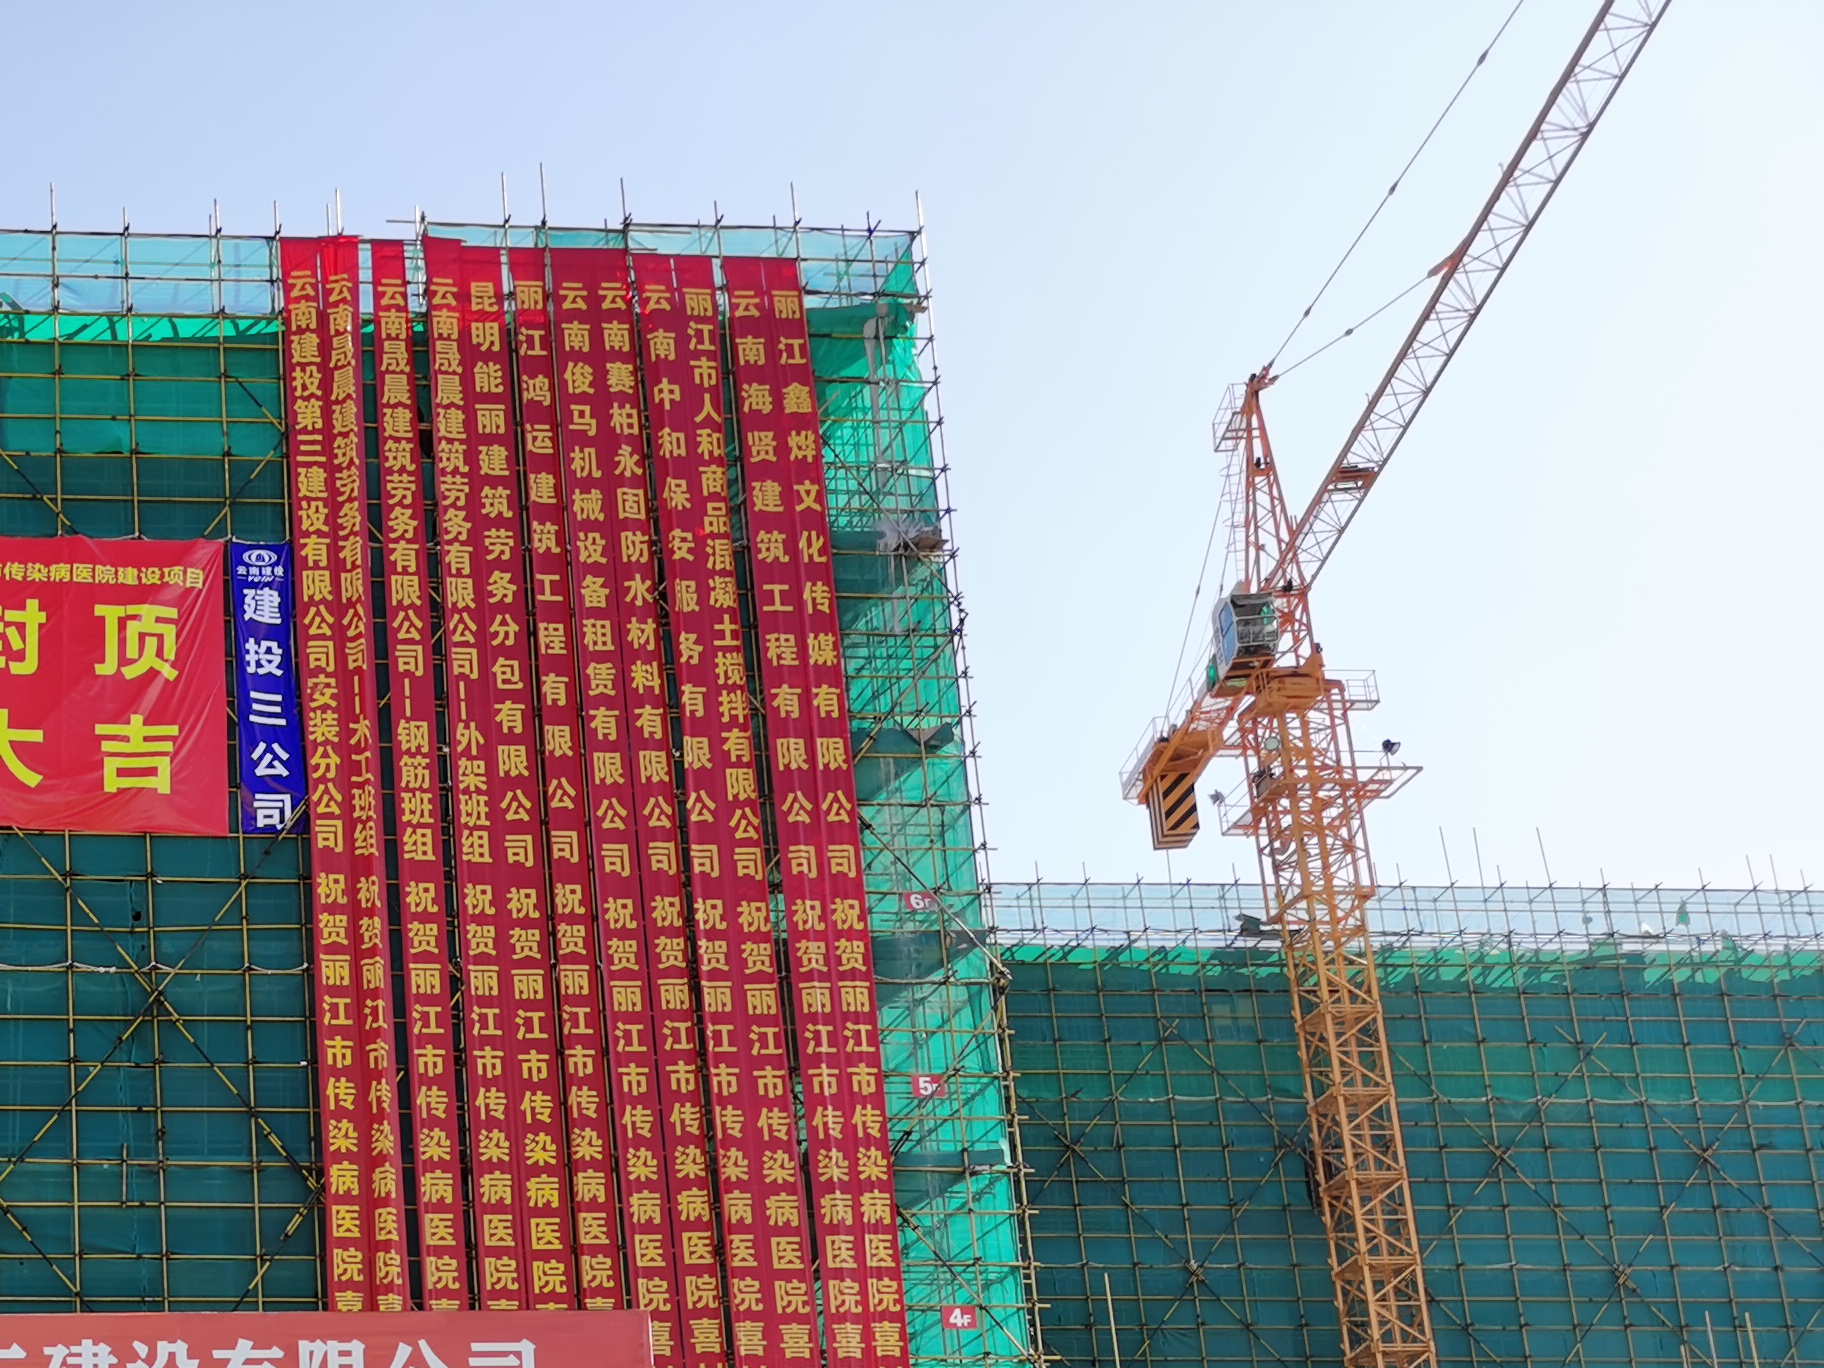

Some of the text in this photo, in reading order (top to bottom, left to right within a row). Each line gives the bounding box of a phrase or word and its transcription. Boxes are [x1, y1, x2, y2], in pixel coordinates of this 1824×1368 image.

[242, 586, 292, 830] 建投三公司
[471, 282, 565, 1310] 昆明能丽建筑劳务分包有限公司祝贺丽江市传染病医院
[949, 1308, 972, 1327] 4F
